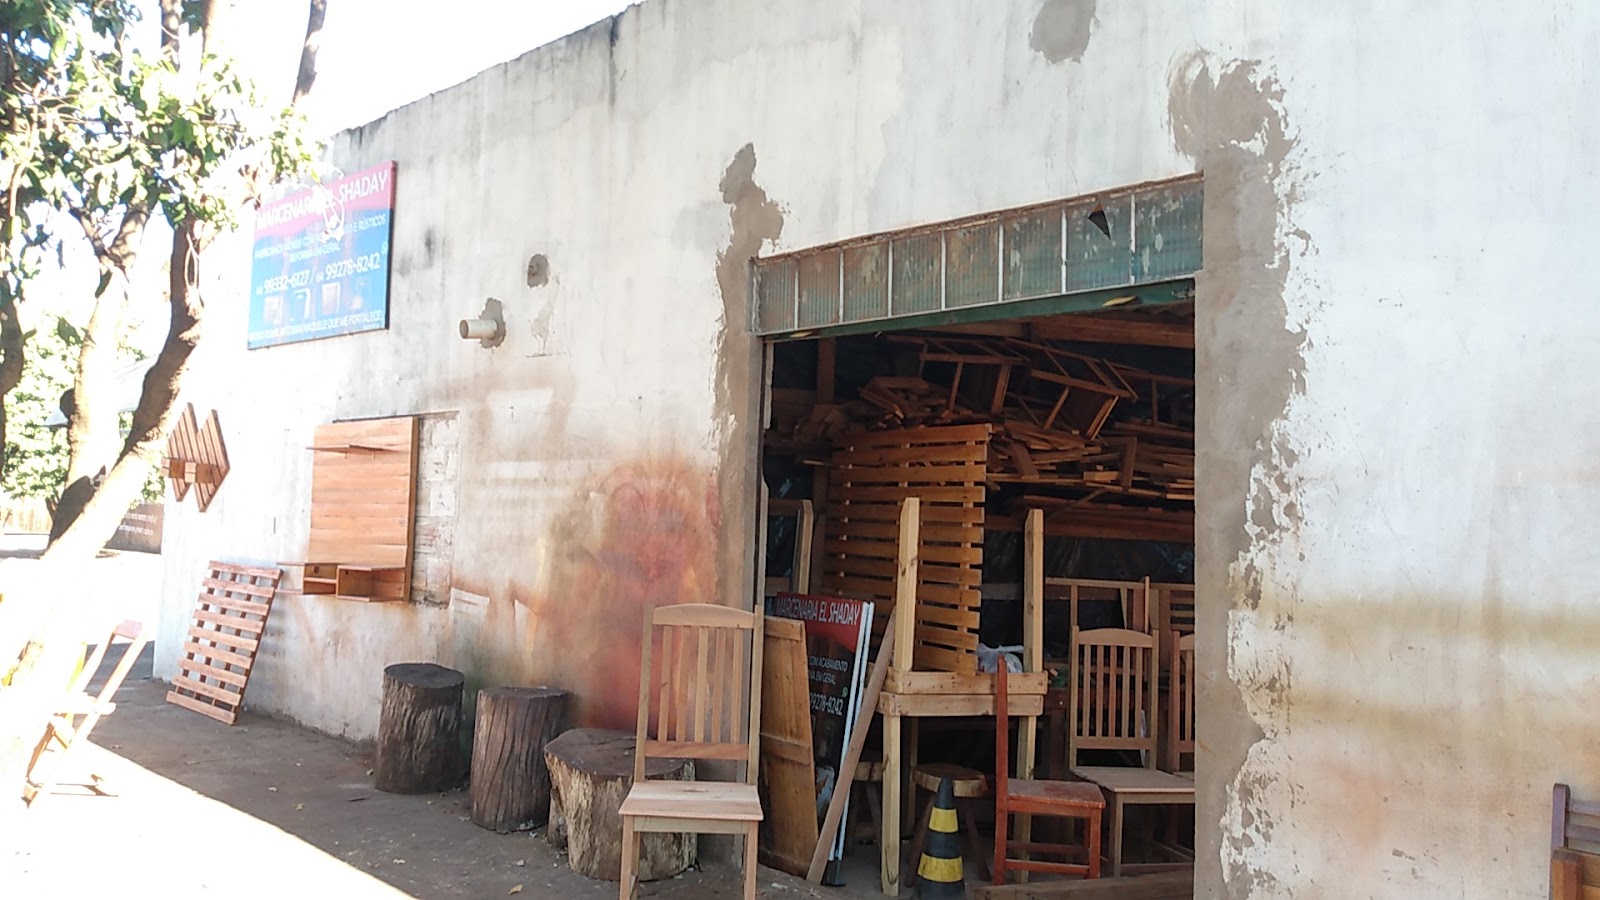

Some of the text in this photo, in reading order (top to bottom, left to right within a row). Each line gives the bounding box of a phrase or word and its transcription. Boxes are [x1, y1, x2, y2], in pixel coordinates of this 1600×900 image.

[339, 170, 388, 203] SHADAY
[325, 252, 381, 281] 99278-8242
[777, 597, 861, 626] MARCENARIA EL SHADAY
